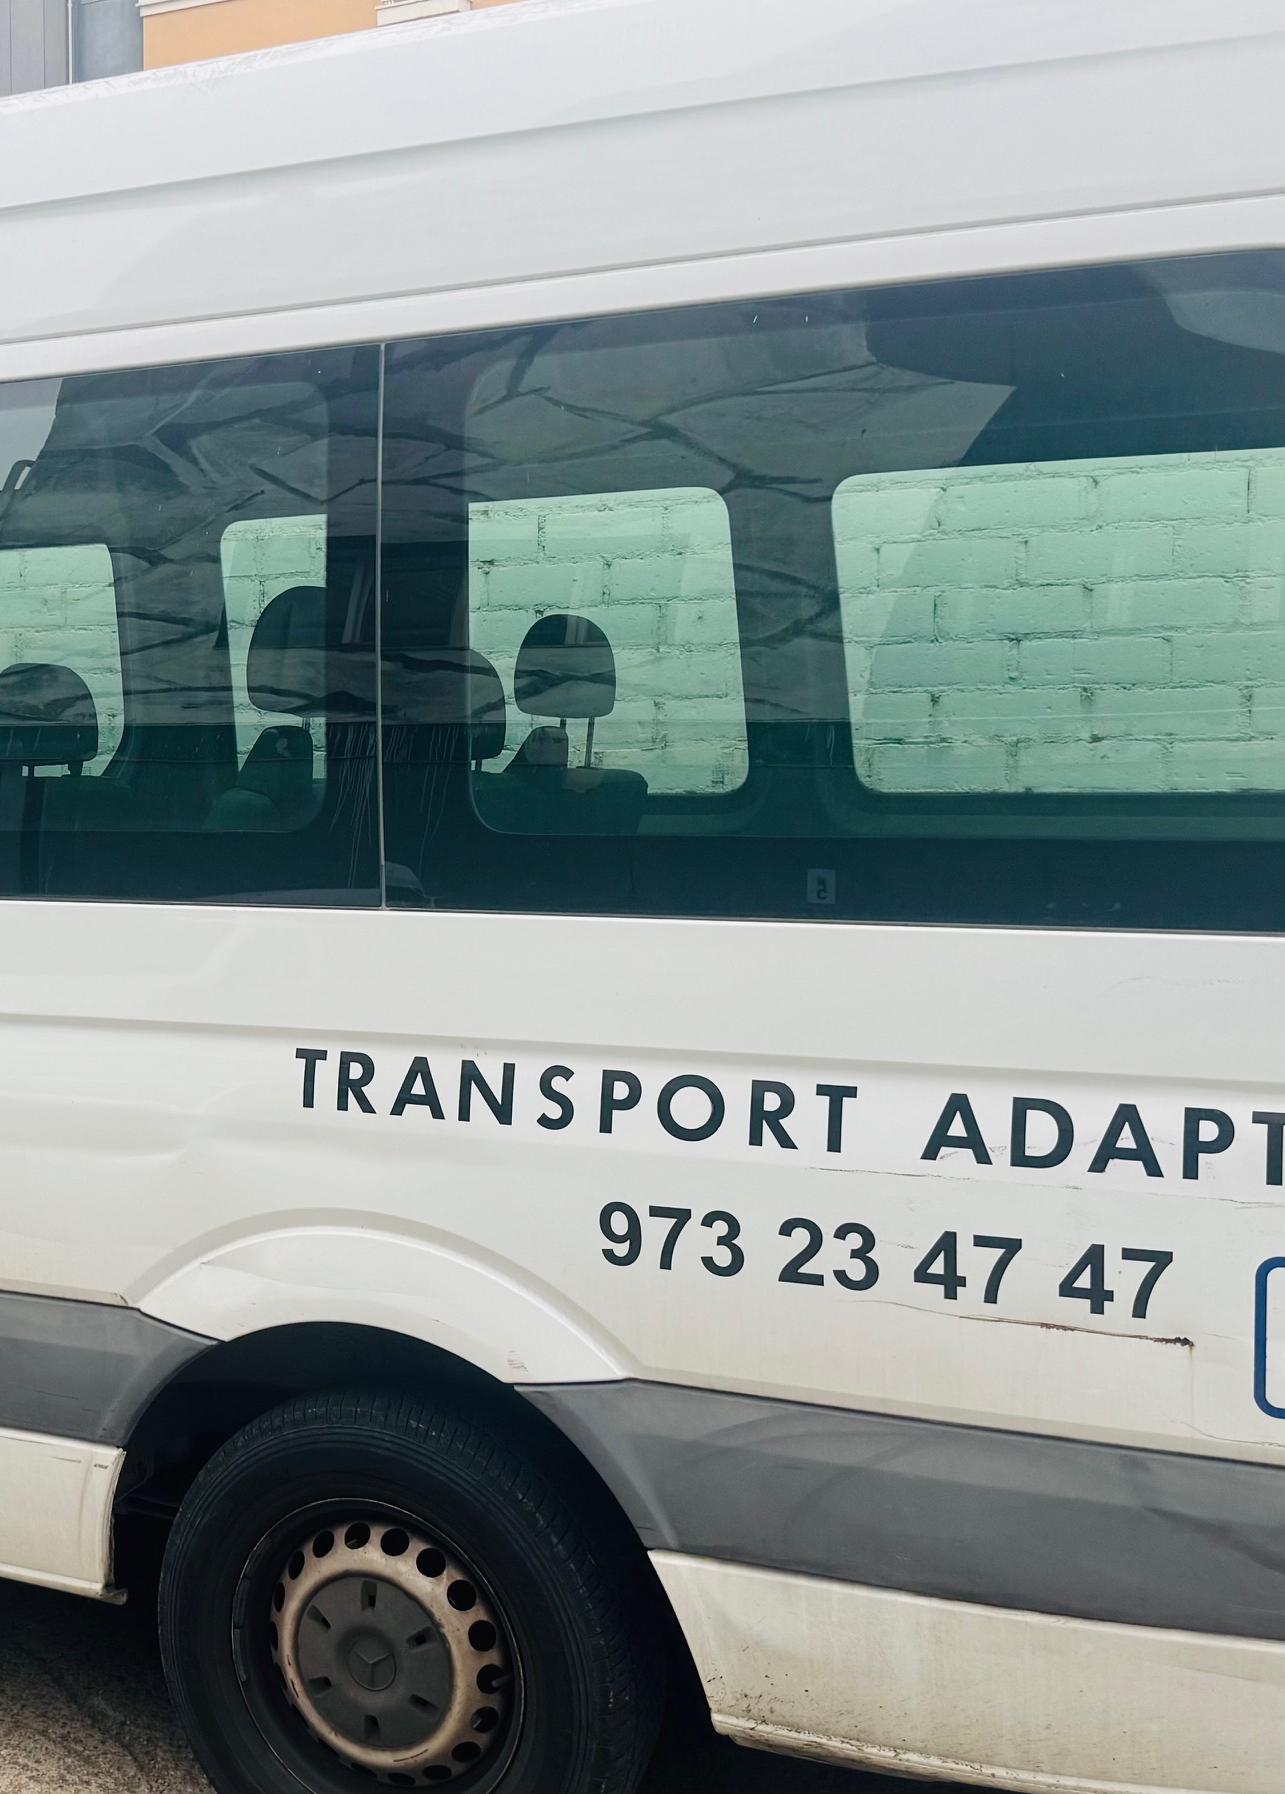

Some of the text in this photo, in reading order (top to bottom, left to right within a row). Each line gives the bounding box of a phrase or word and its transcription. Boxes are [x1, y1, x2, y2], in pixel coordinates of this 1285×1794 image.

[294, 1047, 859, 1155] TRANSPORT
[598, 1201, 1175, 1320] 973 23 47 47
